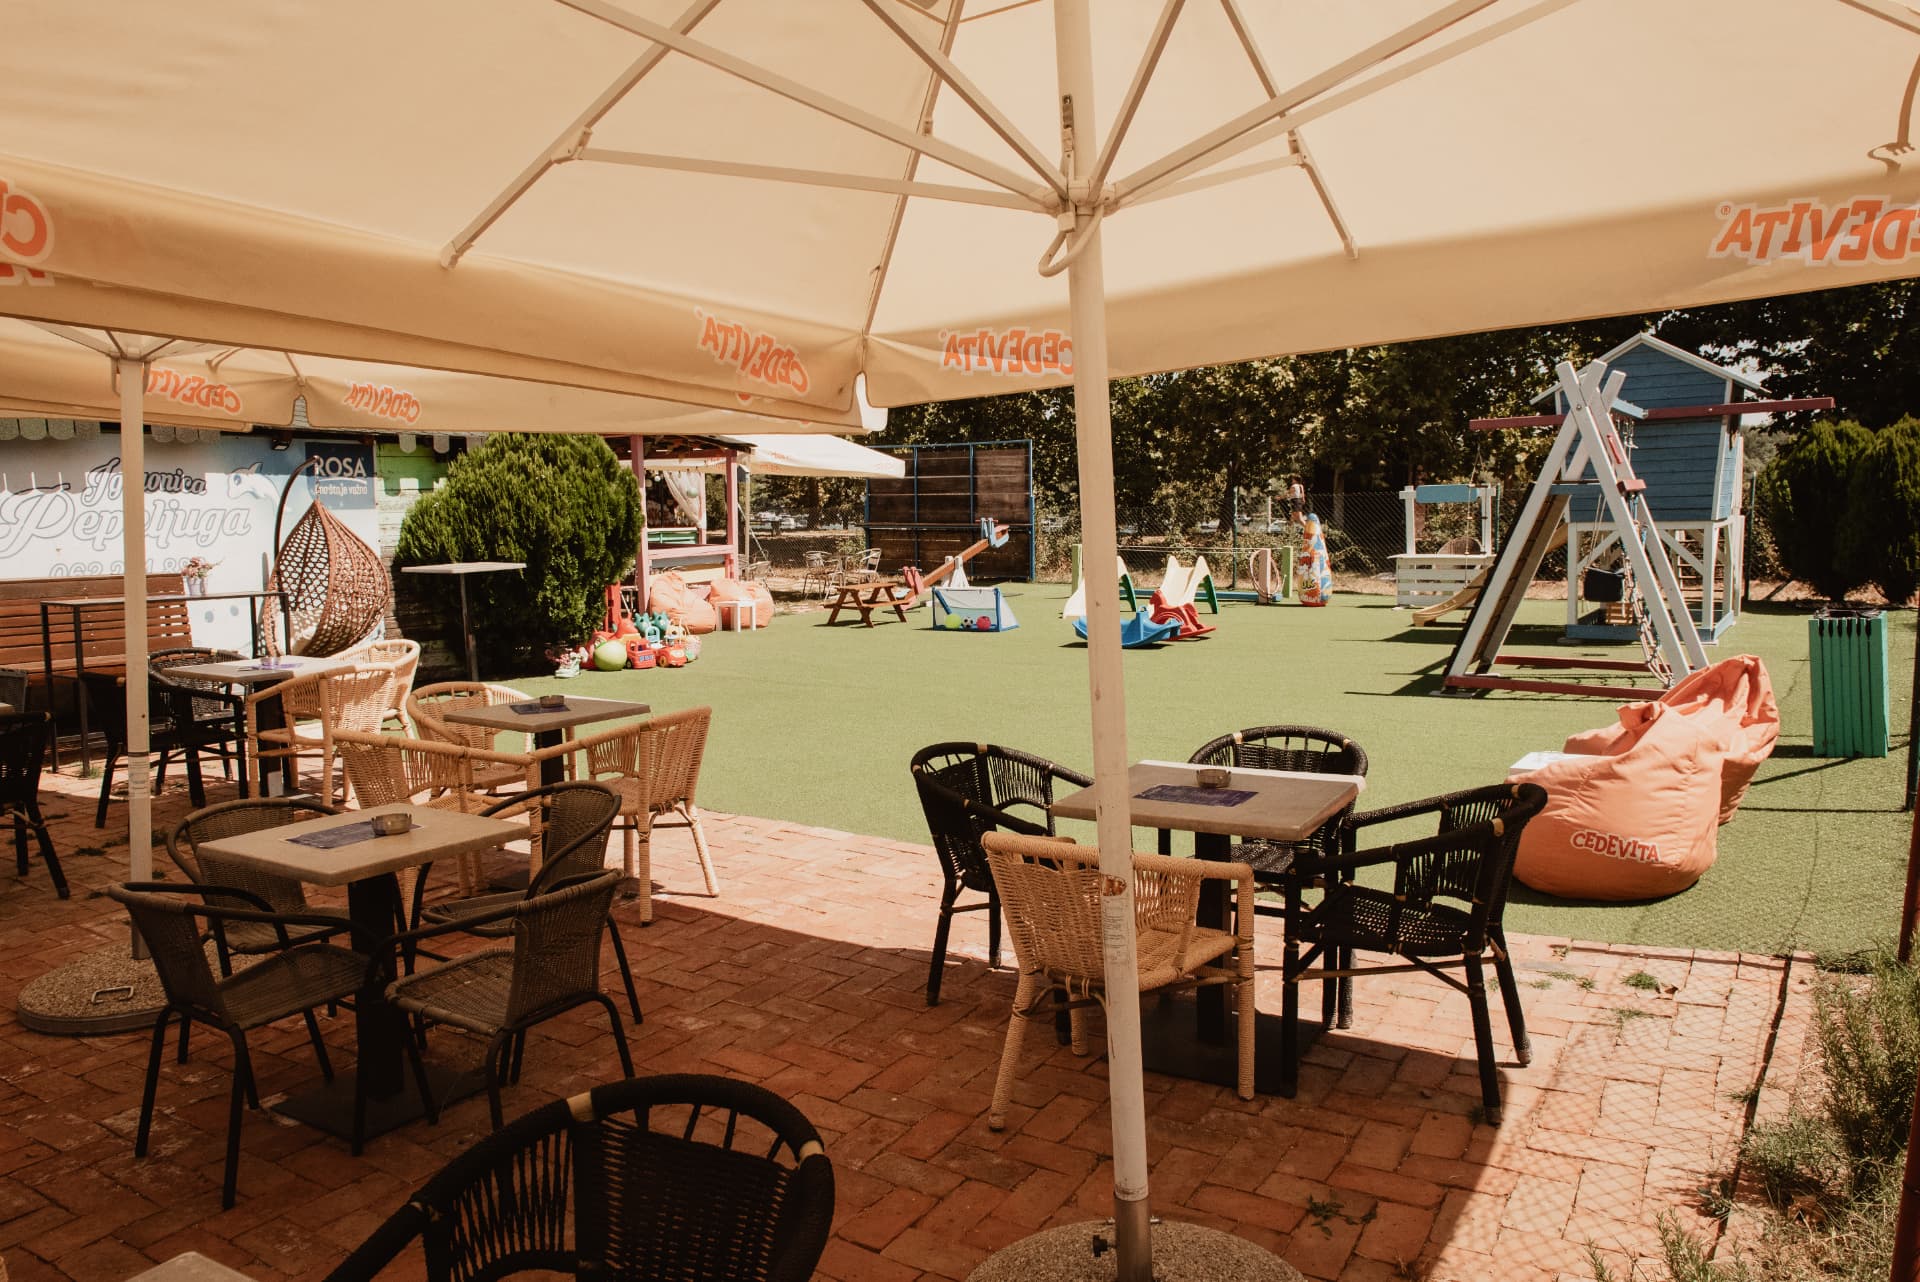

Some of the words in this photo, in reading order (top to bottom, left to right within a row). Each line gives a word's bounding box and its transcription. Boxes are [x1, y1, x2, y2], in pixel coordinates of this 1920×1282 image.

[81, 457, 207, 507] Igonica
[316, 456, 367, 476] ROSA
[0, 483, 251, 559] Pepljuga
[1572, 831, 1659, 862] CEDEVITA
